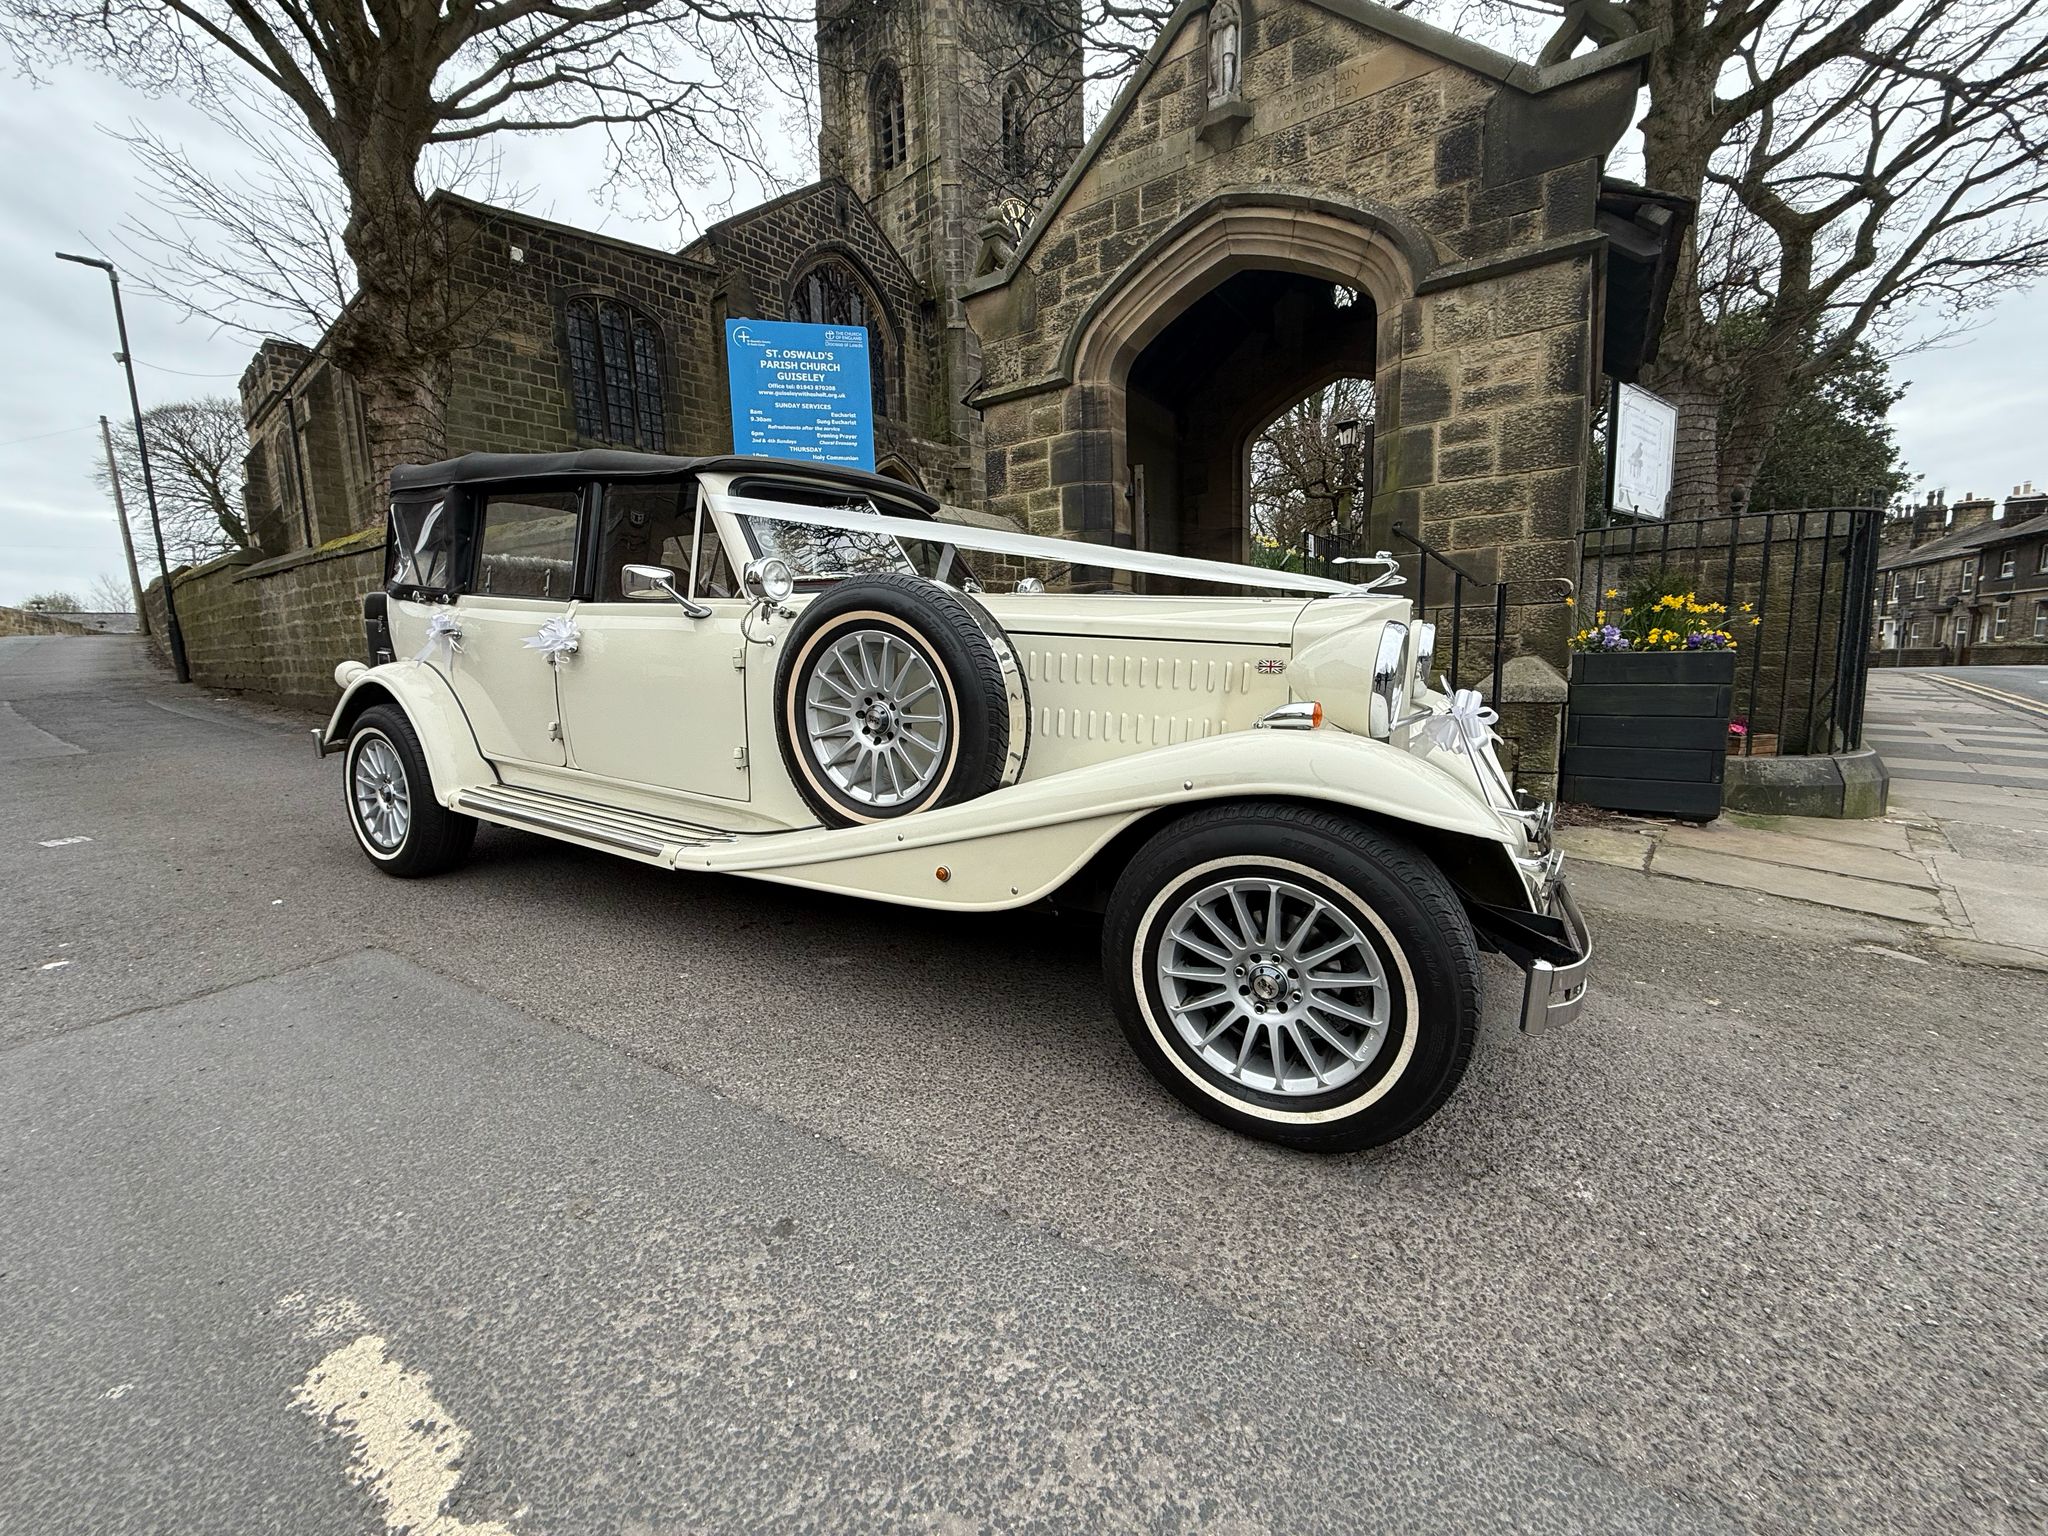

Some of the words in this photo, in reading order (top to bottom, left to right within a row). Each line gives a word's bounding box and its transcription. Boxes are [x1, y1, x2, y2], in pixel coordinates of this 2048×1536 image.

[765, 349, 781, 358] ST.
[783, 350, 834, 360] OSWALD'S
[760, 360, 798, 370] PARISH
[800, 361, 841, 372] CHURCH
[777, 372, 825, 382] GUISELEY
